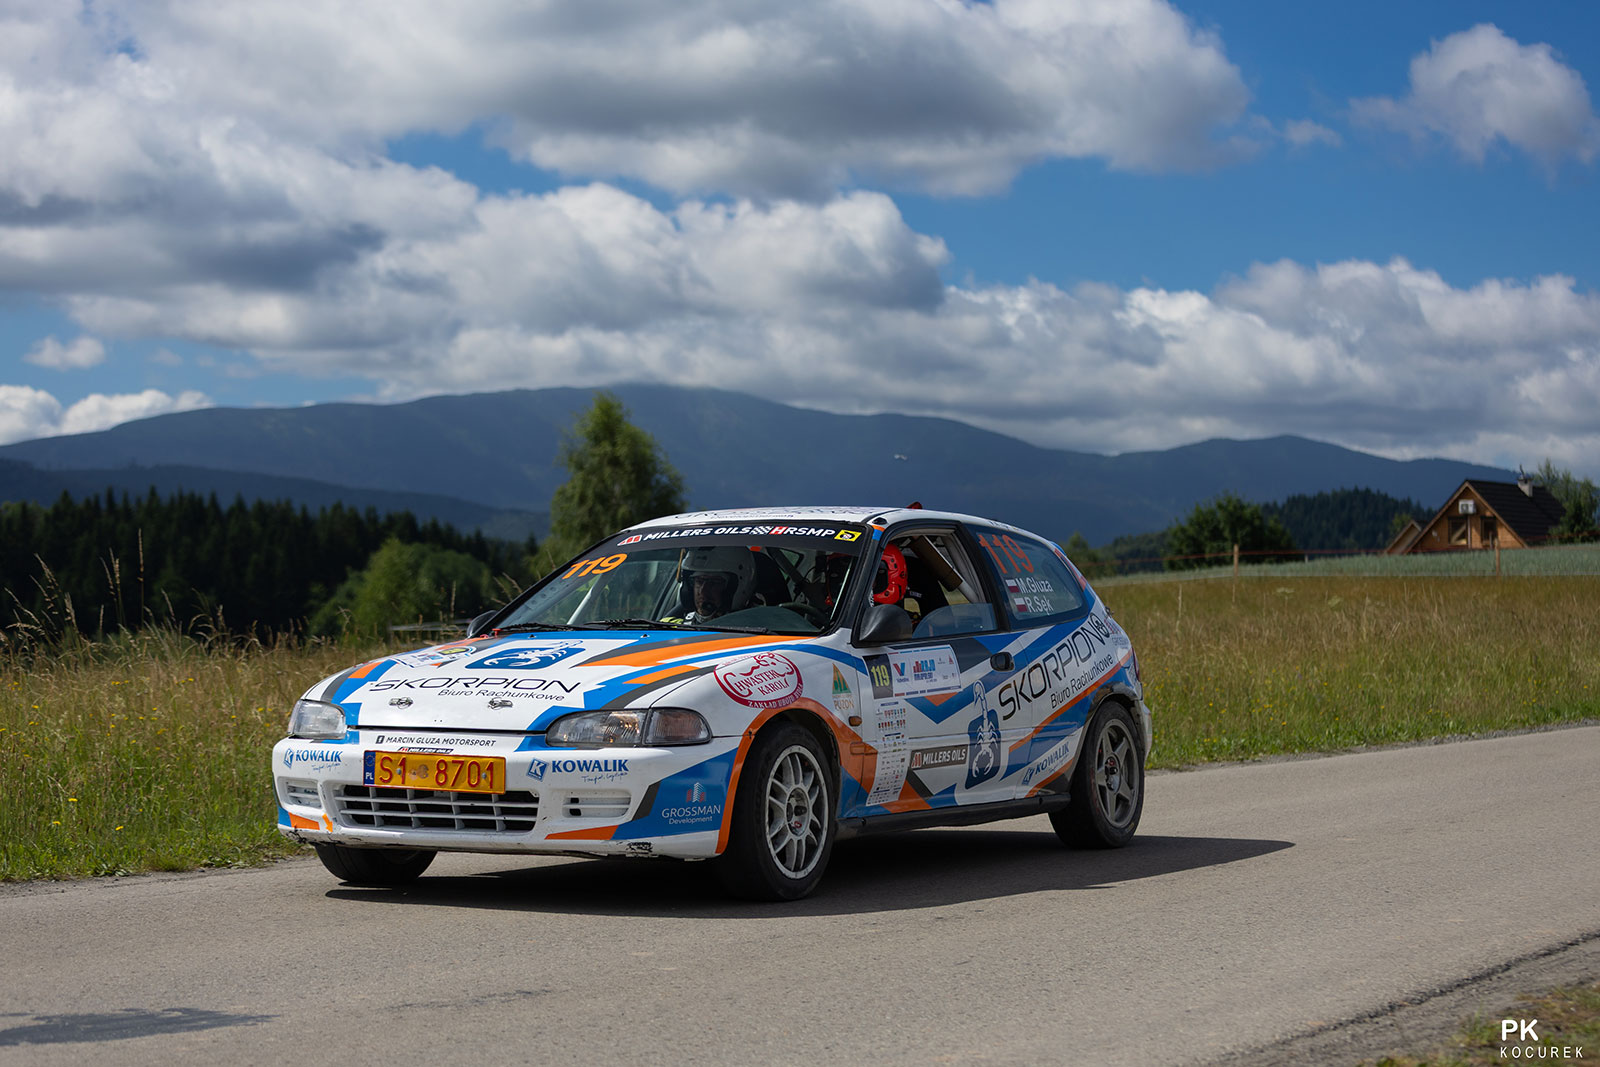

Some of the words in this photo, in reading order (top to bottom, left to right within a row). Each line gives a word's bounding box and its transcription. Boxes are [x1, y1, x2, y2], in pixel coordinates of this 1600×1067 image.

[643, 527, 712, 541] MILLERS
[714, 526, 752, 536] OILS
[978, 534, 1034, 574] 119
[561, 553, 628, 580] 119
[1015, 577, 1054, 594] M.Gluza
[870, 664, 890, 687] 119
[998, 621, 1106, 721] SKORPION
[369, 677, 581, 694] SKORPION
[757, 680, 788, 696] KAROL
[1050, 686, 1071, 709] Biuro
[1070, 654, 1114, 694] Rachunkowe
[437, 689, 474, 697] Biuro
[475, 689, 565, 701] Rachunkowe
[386, 736, 414, 744] MARCIN
[415, 737, 440, 745] GLUZA
[441, 738, 497, 747] MOTORSPORT
[295, 749, 343, 762] KOWALIK
[922, 751, 951, 765] MILLERS
[951, 749, 966, 762] OILS
[1035, 741, 1070, 775] KOWALIK
[379, 755, 407, 785] S1
[435, 758, 494, 789] 8701
[551, 759, 629, 773] KOWALIK
[364, 772, 374, 780] PL
[661, 804, 721, 818] GROSSMAN
[668, 815, 713, 825] Development
